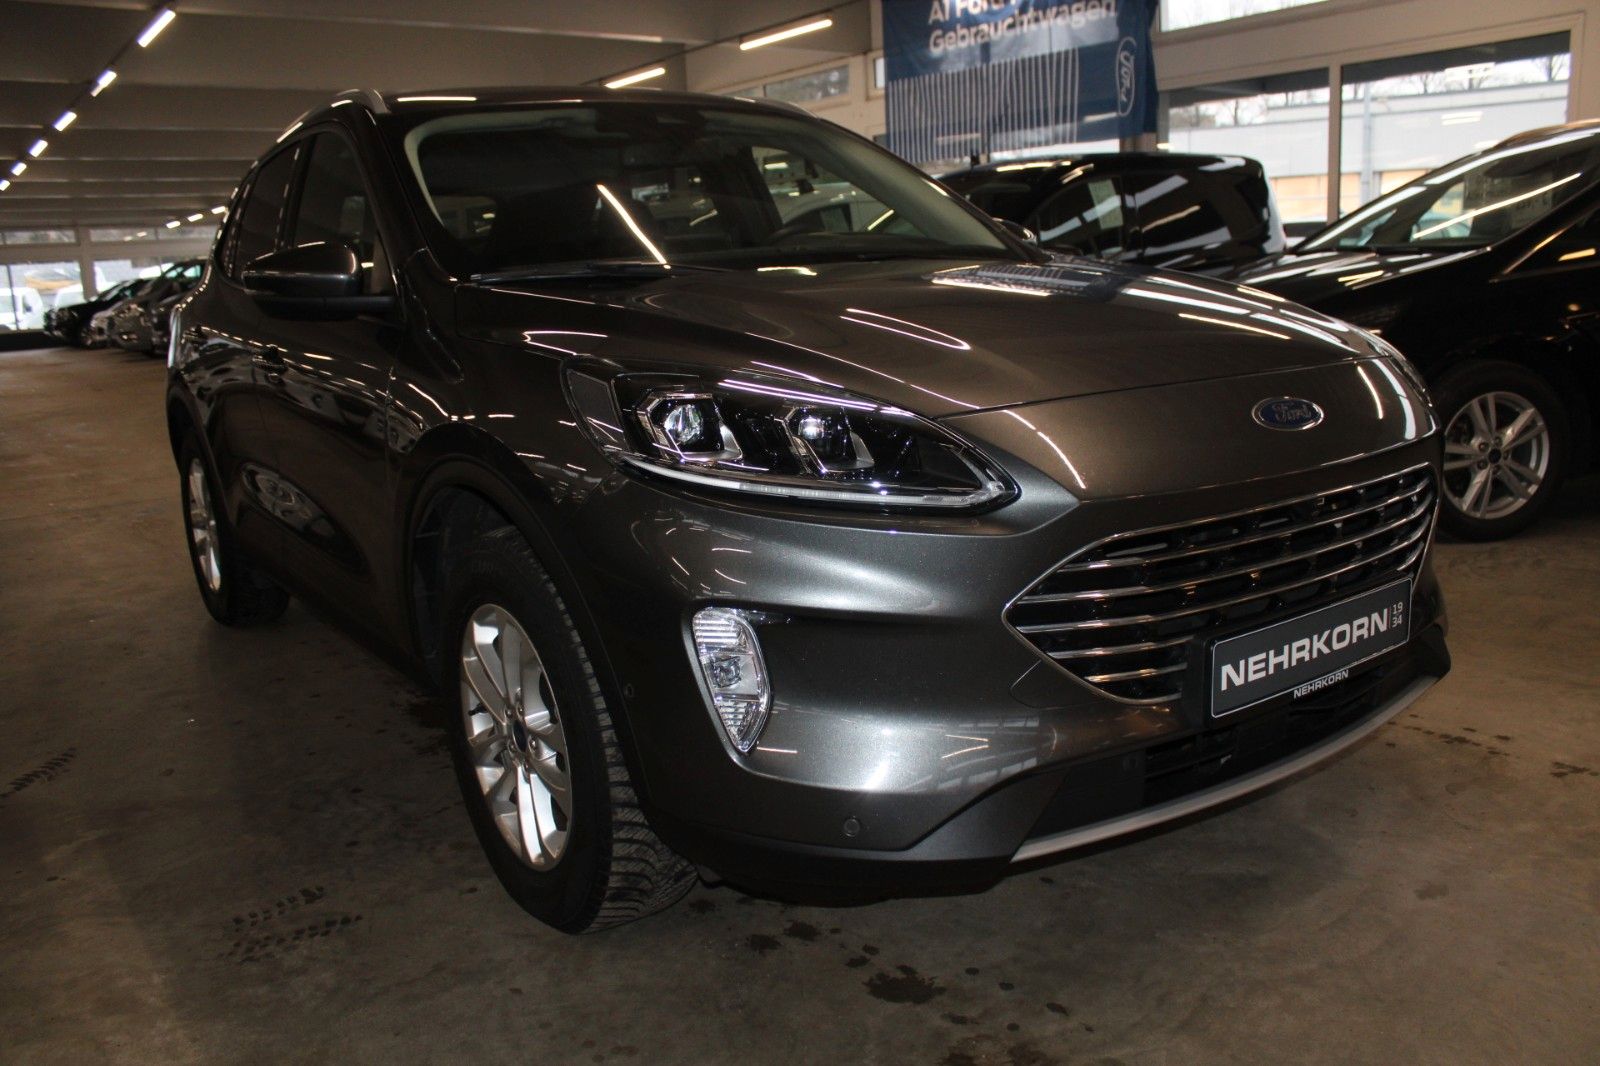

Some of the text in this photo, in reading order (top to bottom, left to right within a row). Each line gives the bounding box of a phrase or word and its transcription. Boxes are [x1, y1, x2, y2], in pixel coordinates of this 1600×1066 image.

[929, 0, 1117, 54] Gebrauchtwagen
[1391, 614, 1403, 628] 34
[1392, 602, 1404, 615] 19
[1221, 608, 1388, 691] NEHRKORN
[1293, 669, 1349, 699] NEHRKORN
